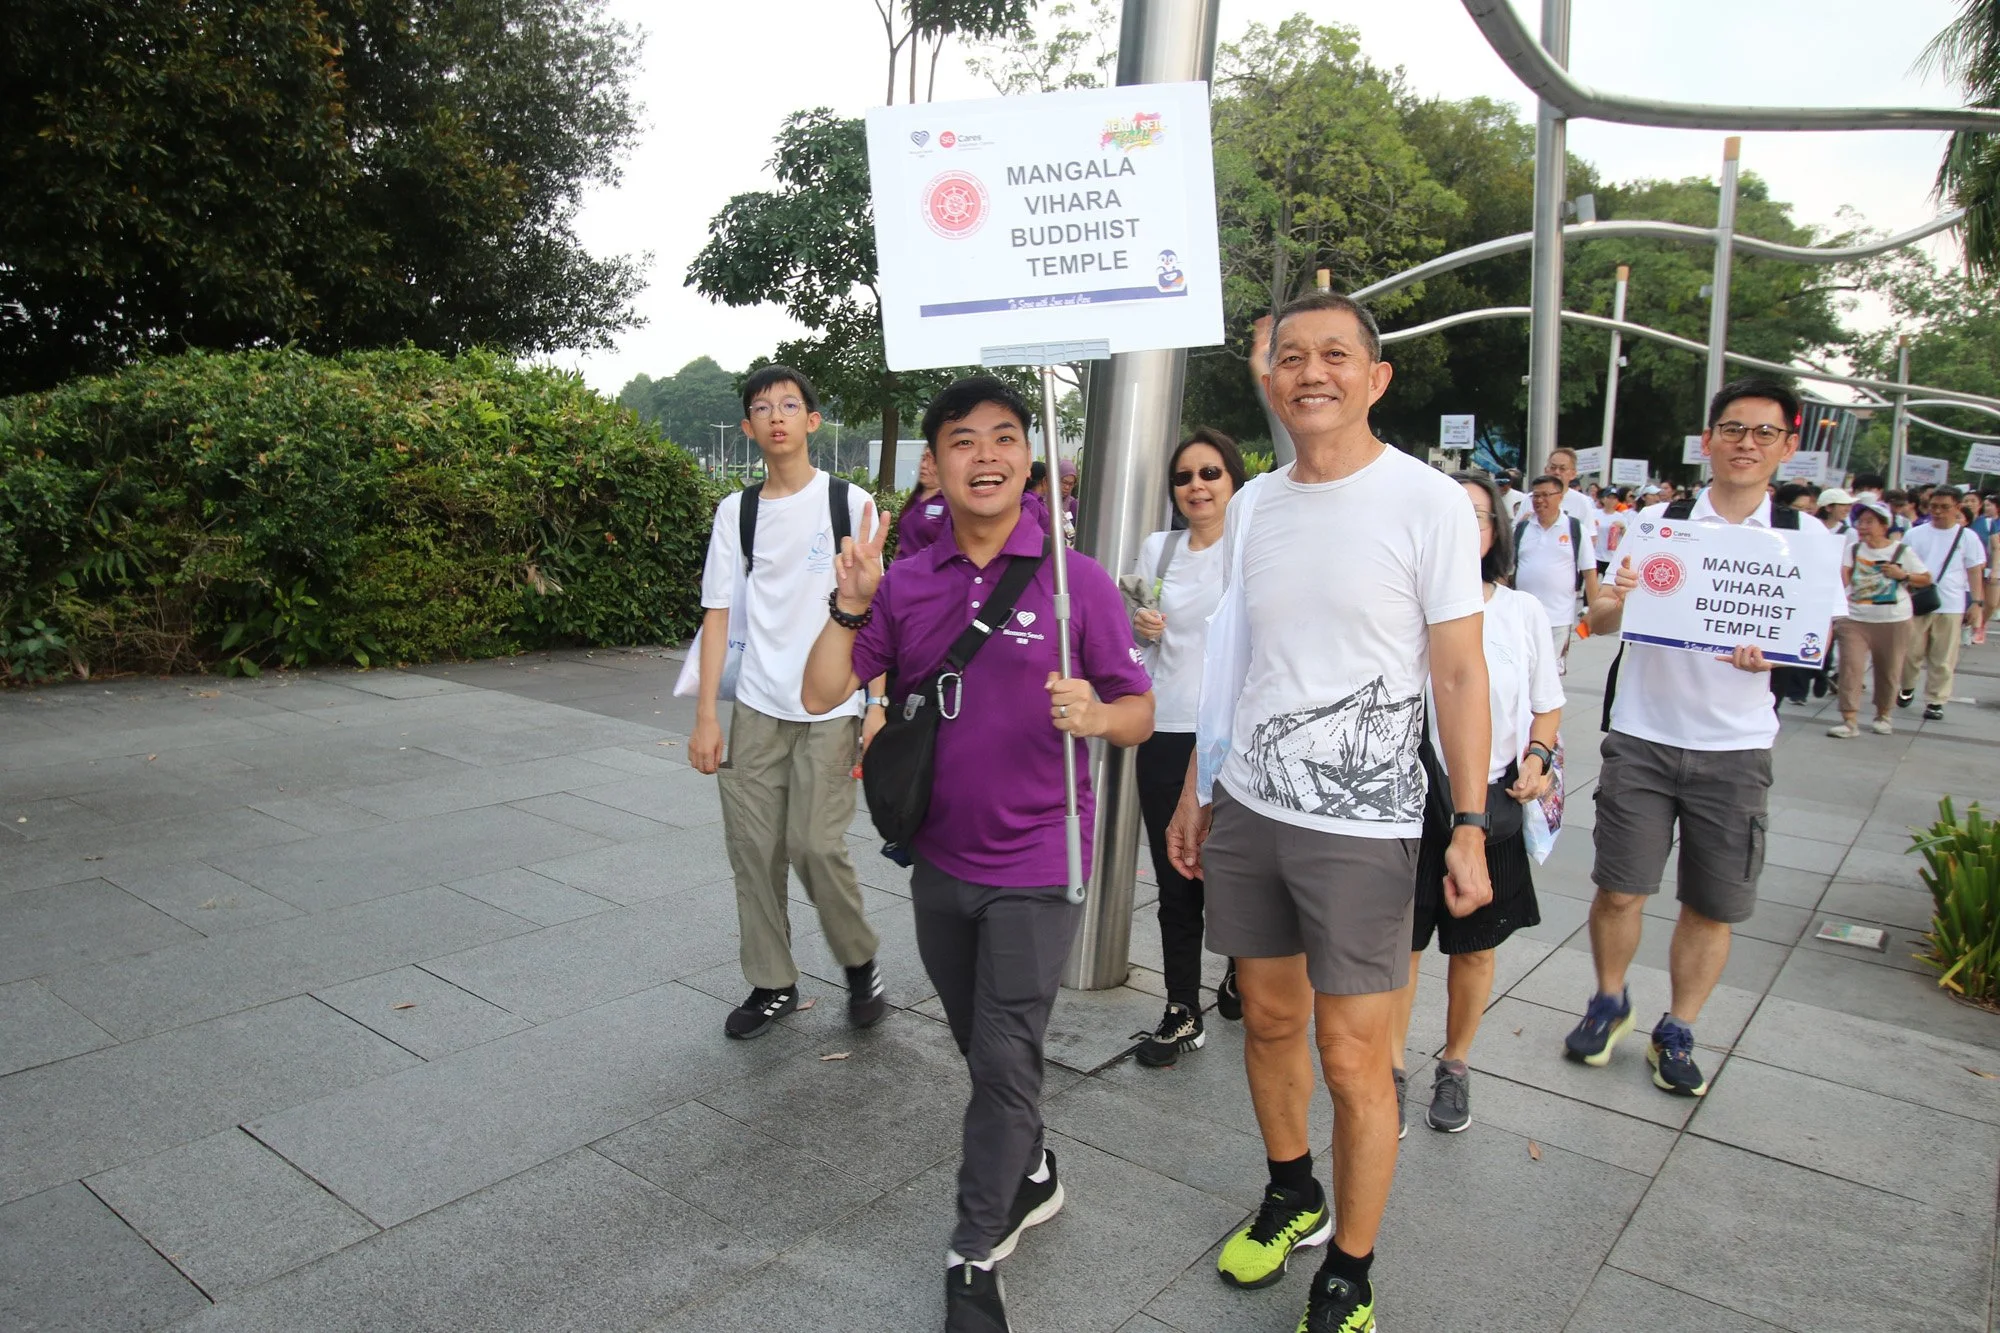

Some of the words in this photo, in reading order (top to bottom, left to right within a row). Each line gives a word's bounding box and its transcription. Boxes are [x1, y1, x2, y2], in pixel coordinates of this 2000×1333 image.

[958, 133, 983, 144] Cares
[1007, 156, 1136, 186] MANGALA
[1024, 189, 1122, 215] VIHARA
[1011, 218, 1140, 247] BUDDHIST
[1027, 250, 1129, 277] TEMPLE
[1702, 557, 1801, 579] MANGALA
[1712, 579, 1785, 599] VIHARA
[1695, 598, 1796, 620] BUDDHIST
[1703, 619, 1780, 640] TEMPLE
